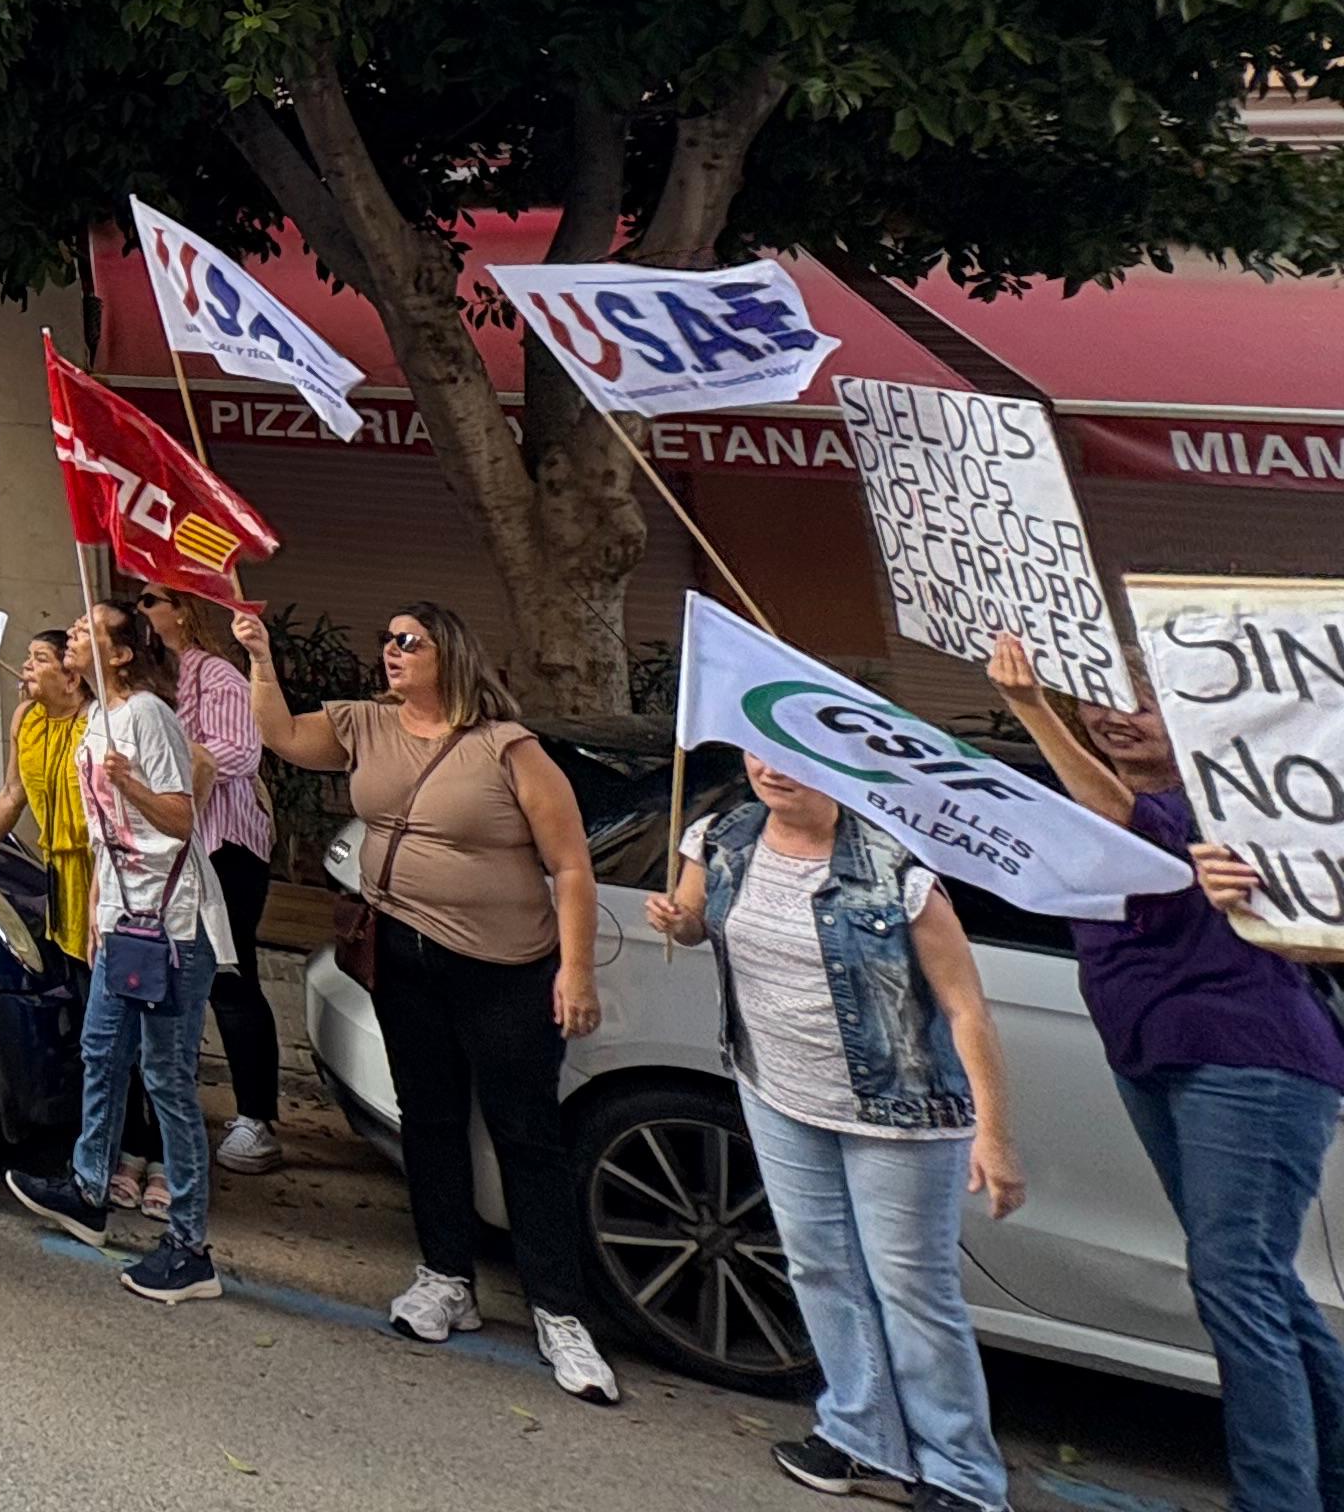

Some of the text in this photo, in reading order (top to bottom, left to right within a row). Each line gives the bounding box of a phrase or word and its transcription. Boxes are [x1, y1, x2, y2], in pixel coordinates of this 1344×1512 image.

[211, 399, 434, 447] PIZZRIA
[838, 377, 1035, 459] SUELDOS
[853, 431, 1013, 508] DIGNOS
[865, 475, 1090, 578] NO ES COSA
[875, 512, 1102, 622] DE CARIDAD
[890, 567, 978, 626] SINO
[1047, 609, 1114, 669] ES
[925, 614, 1114, 709] JUSCIA
[814, 706, 1038, 802] CSIF
[1191, 735, 1344, 825] NO
[864, 789, 1023, 877] BALEARS
[937, 797, 1035, 860] ILLES
